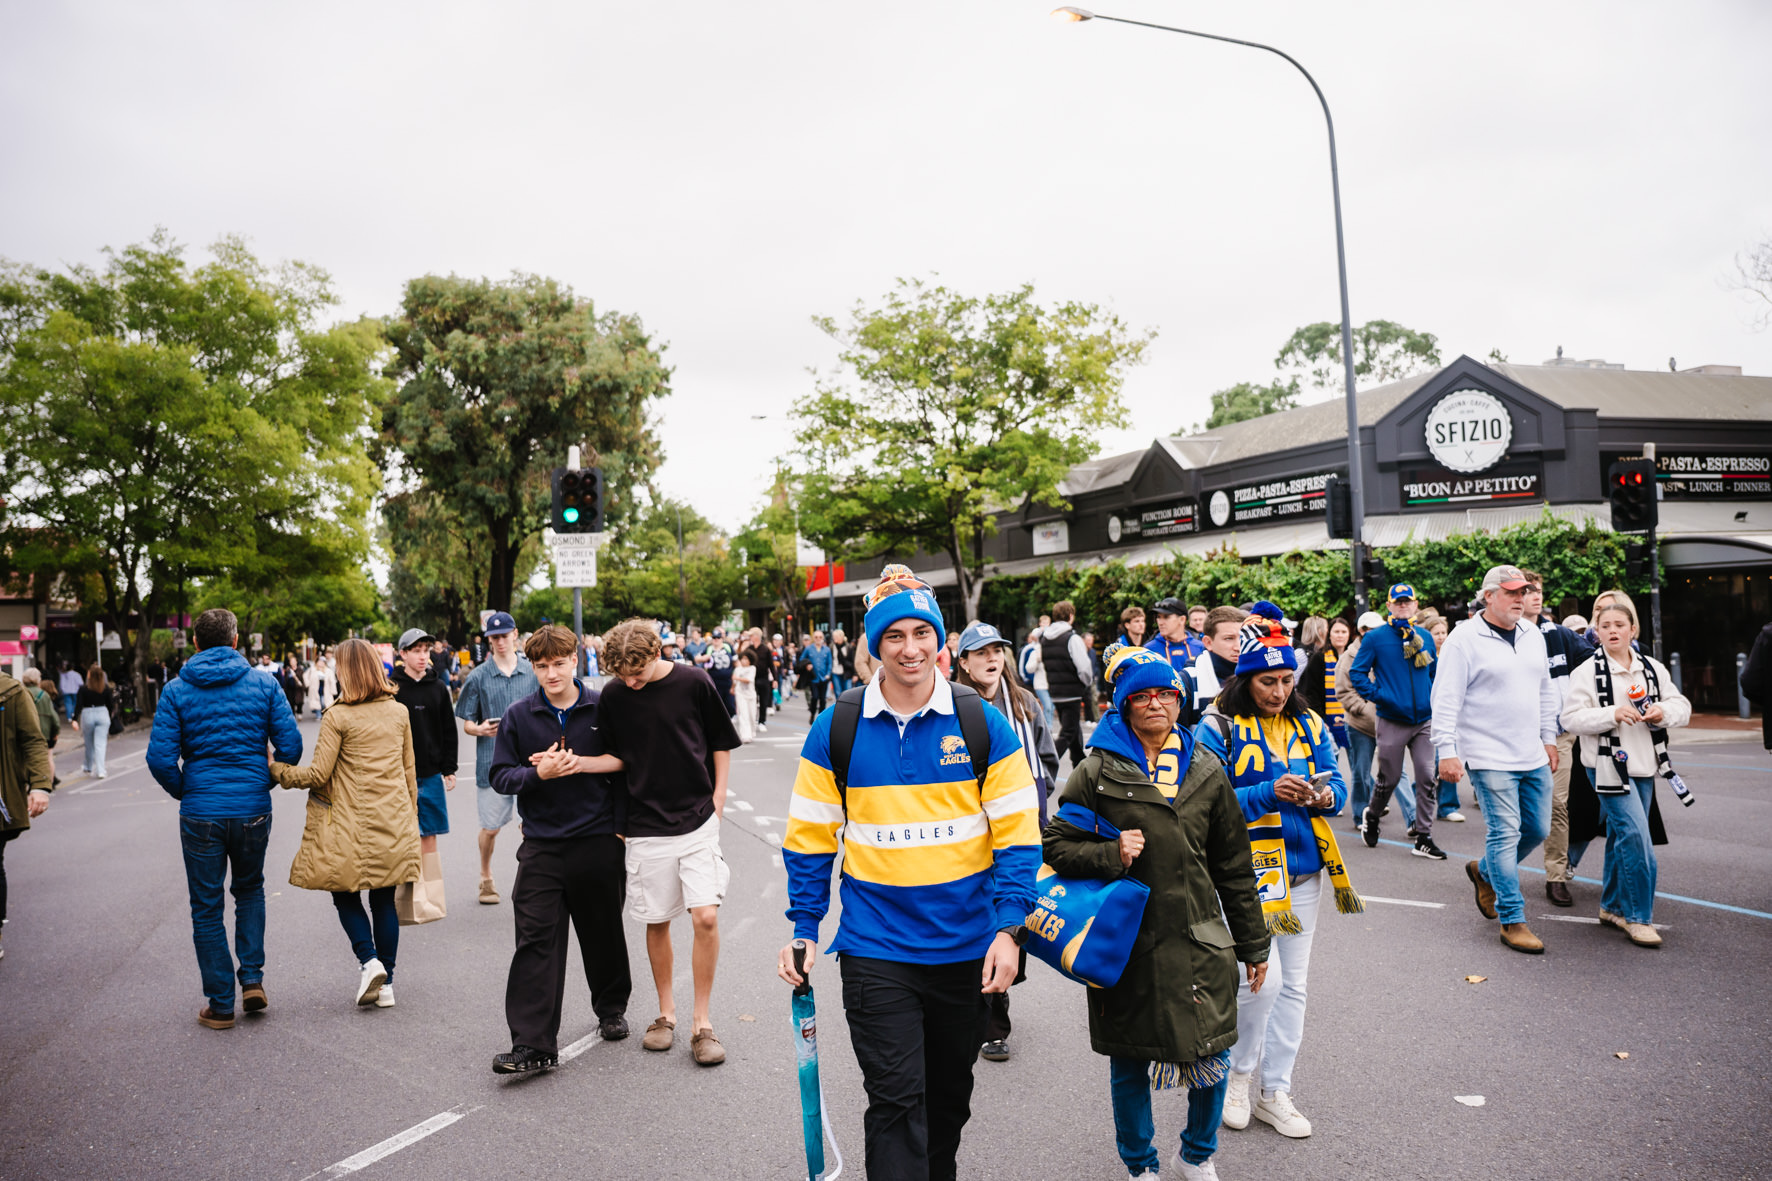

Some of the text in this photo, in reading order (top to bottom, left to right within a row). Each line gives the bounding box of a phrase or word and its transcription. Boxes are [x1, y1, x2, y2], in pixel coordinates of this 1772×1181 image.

[1435, 418, 1502, 444] SFIZIO
[1706, 457, 1770, 471] ESPRESSO
[1689, 482, 1723, 492] LUNCH
[1733, 482, 1771, 492] DINNER
[1142, 508, 1172, 522] FUNCTION
[1173, 504, 1193, 517] ROOM
[1235, 506, 1273, 521] BREAKFAST
[1278, 501, 1303, 515] LUNCH
[552, 536, 586, 545] OSMOND
[940, 755, 971, 766] EAGLES
[877, 825, 954, 842] EAGLES
